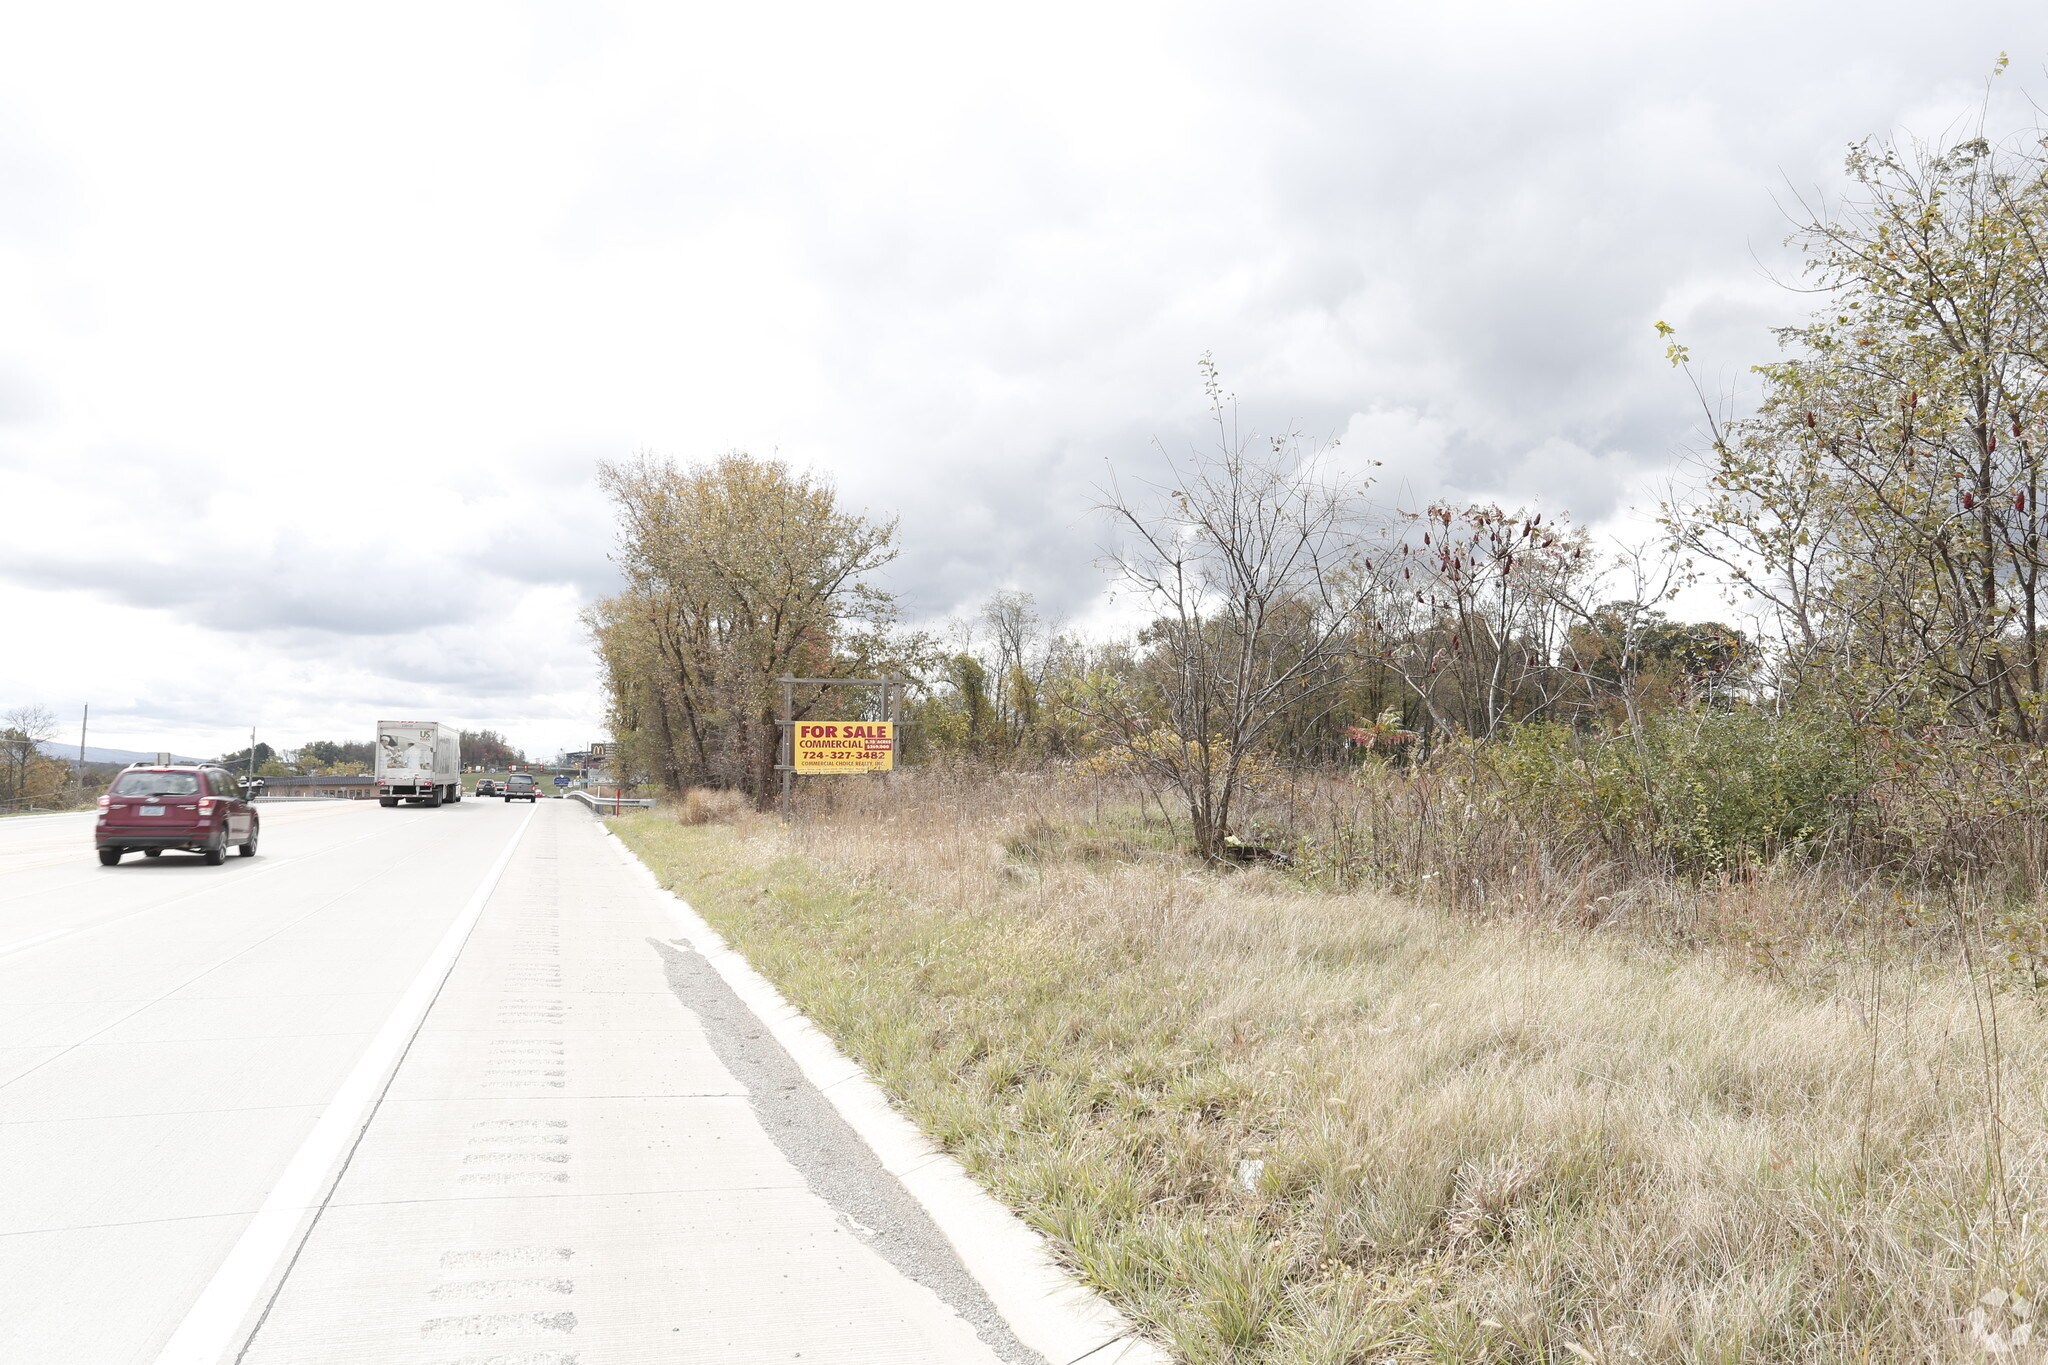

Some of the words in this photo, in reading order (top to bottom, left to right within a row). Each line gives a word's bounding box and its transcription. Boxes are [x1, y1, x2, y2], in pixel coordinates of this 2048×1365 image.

[801, 726, 838, 738] FOR
[843, 726, 886, 738] SALE
[800, 740, 863, 748] COMMERCIAL
